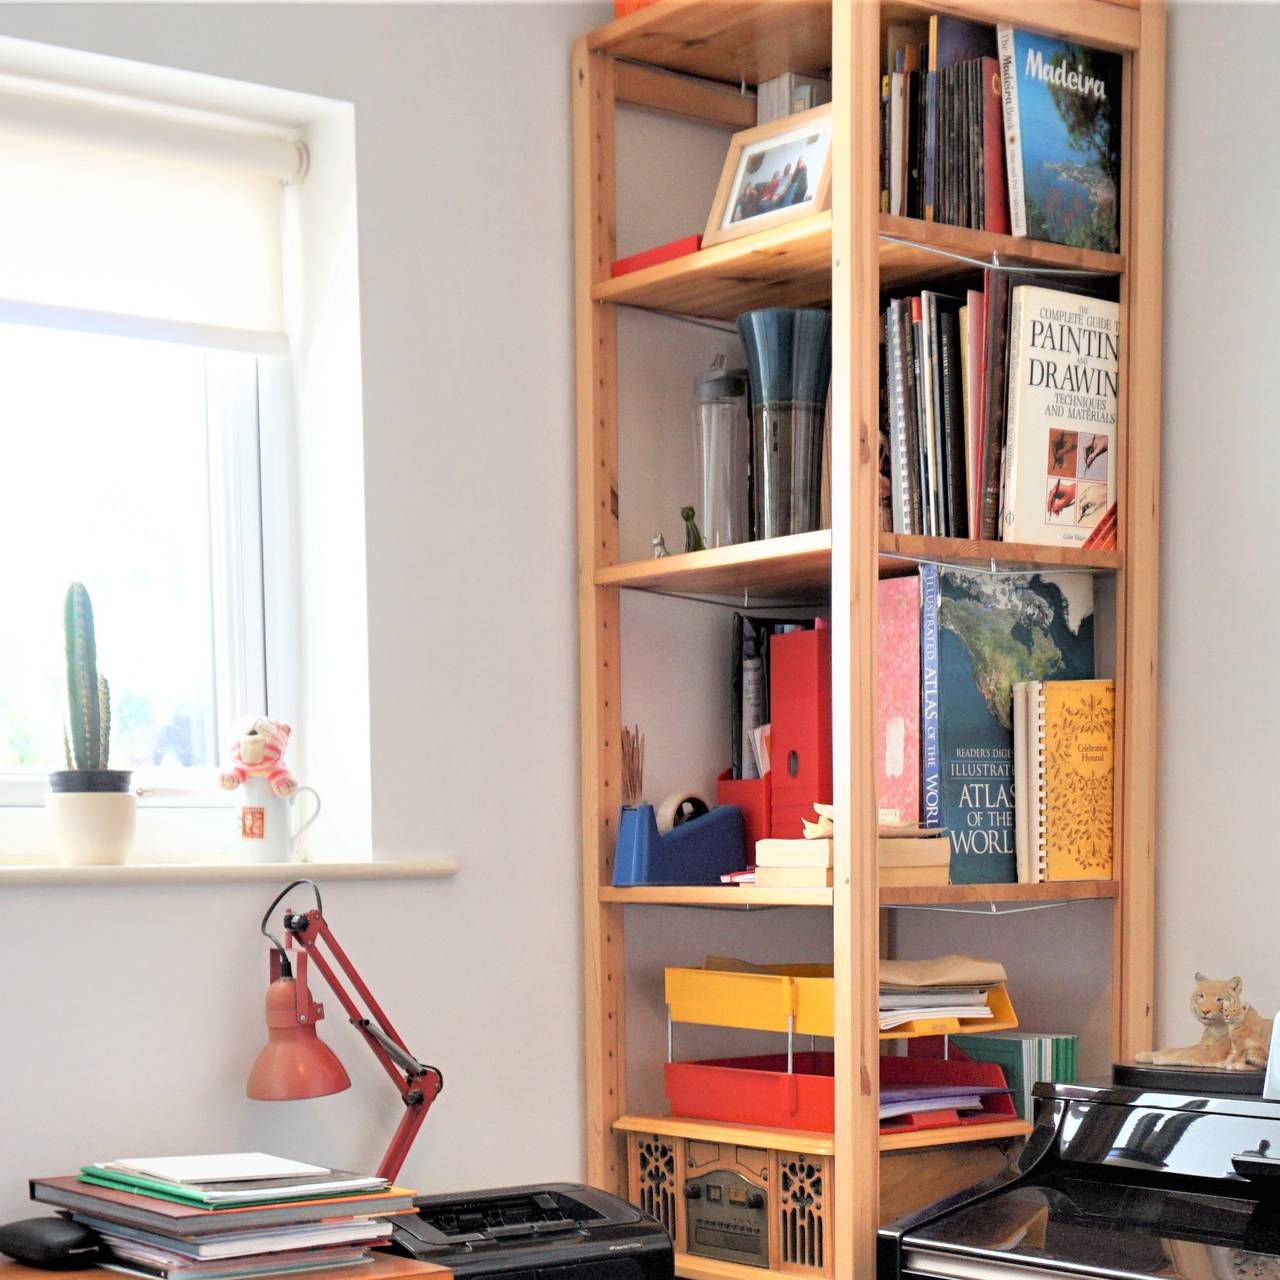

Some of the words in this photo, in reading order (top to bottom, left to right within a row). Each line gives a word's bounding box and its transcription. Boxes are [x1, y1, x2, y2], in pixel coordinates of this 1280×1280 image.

[1002, 54, 1014, 104] Madeira
[1025, 48, 1106, 99] Madeira
[1040, 307, 1084, 325] COMPLETE
[1087, 316, 1112, 331] GUIDE
[1030, 320, 1120, 362] PAINTIN
[1028, 358, 1119, 398] DRAWIN
[1055, 393, 1106, 410] TECHNIQUES
[1045, 404, 1064, 417] AND
[1068, 407, 1116, 424] MATERIALS
[926, 576, 936, 660] ILLUSTRATED
[925, 667, 937, 720] ATLAS
[928, 726, 935, 739] OF
[928, 744, 936, 768] THE
[956, 748, 990, 758] READER'S
[993, 748, 1013, 758] DIGE
[951, 763, 1014, 776] ILLUSTRAT
[926, 774, 938, 828] WORL
[967, 811, 983, 826] OF
[987, 811, 1012, 826] THE
[951, 829, 1013, 854] WORL
